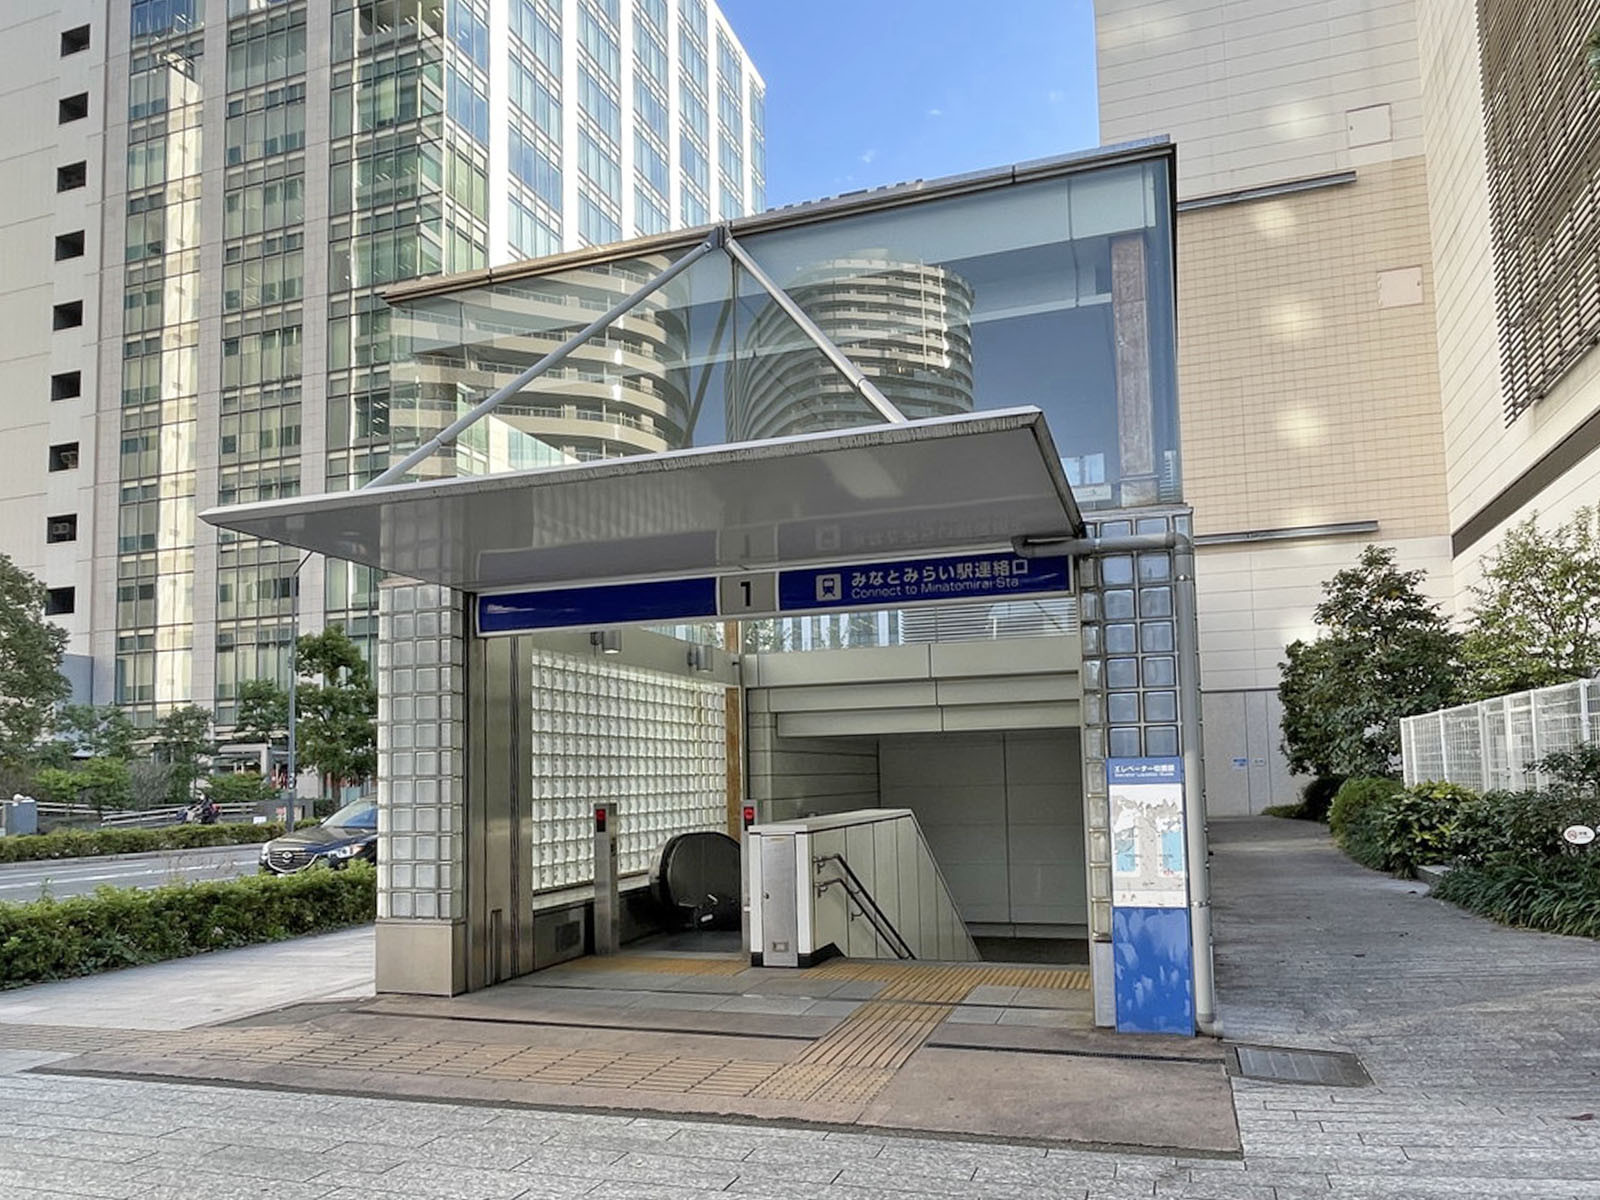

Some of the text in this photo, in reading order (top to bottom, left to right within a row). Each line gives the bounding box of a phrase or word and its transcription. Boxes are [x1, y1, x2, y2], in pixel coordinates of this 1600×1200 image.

[851, 560, 1028, 587] みなとみらい駅連絡口
[740, 581, 751, 607] 1
[851, 587, 902, 599] Connect
[905, 585, 918, 595] to
[921, 579, 993, 594] Minatomirai
